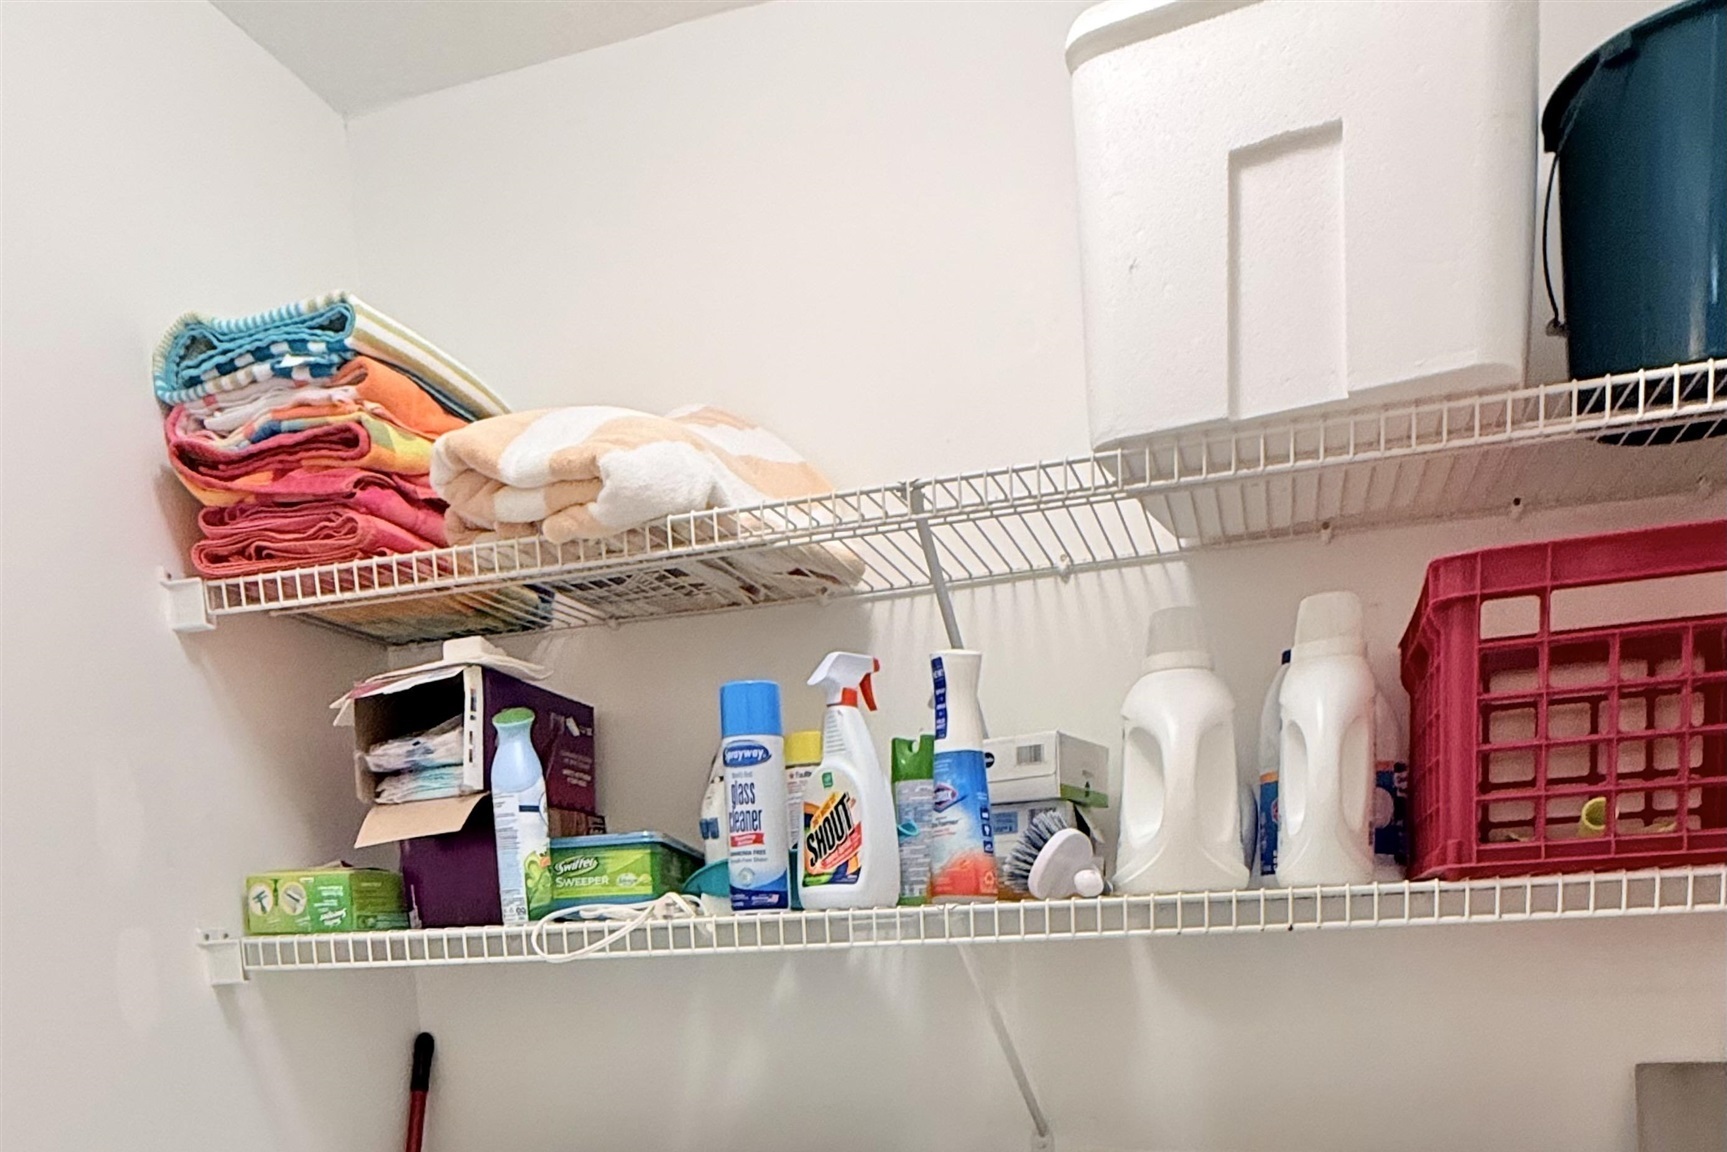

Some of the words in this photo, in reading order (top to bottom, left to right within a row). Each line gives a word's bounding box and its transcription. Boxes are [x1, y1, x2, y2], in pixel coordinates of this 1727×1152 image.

[725, 747, 764, 763] Sprayway
[731, 780, 755, 809] glass
[729, 809, 762, 833] cleaner
[807, 792, 854, 867] SHOUT
[555, 856, 598, 874] Swiffer
